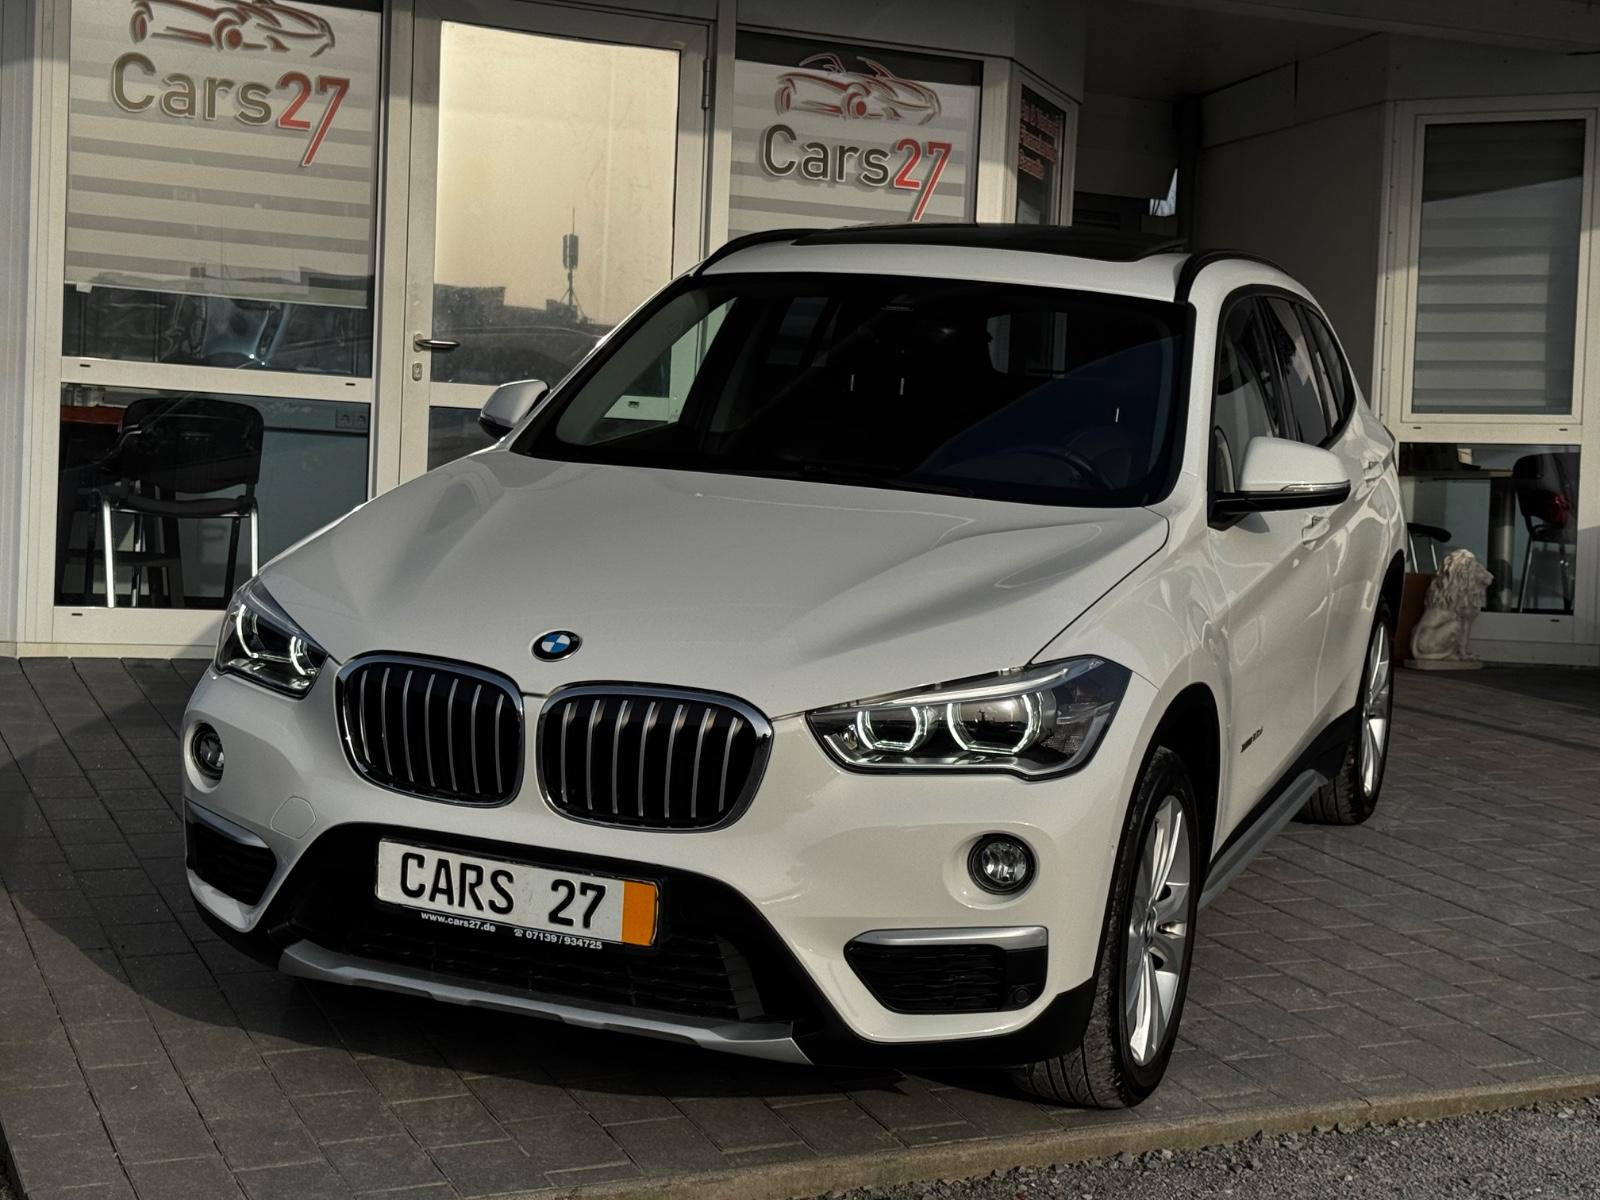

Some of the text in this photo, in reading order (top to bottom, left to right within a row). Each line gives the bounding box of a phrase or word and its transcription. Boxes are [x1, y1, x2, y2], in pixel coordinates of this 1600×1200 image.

[111, 51, 350, 167] Cars27
[763, 123, 952, 222] Cars27
[400, 852, 607, 929] CARS 27
[420, 911, 496, 932] www.cars27.de
